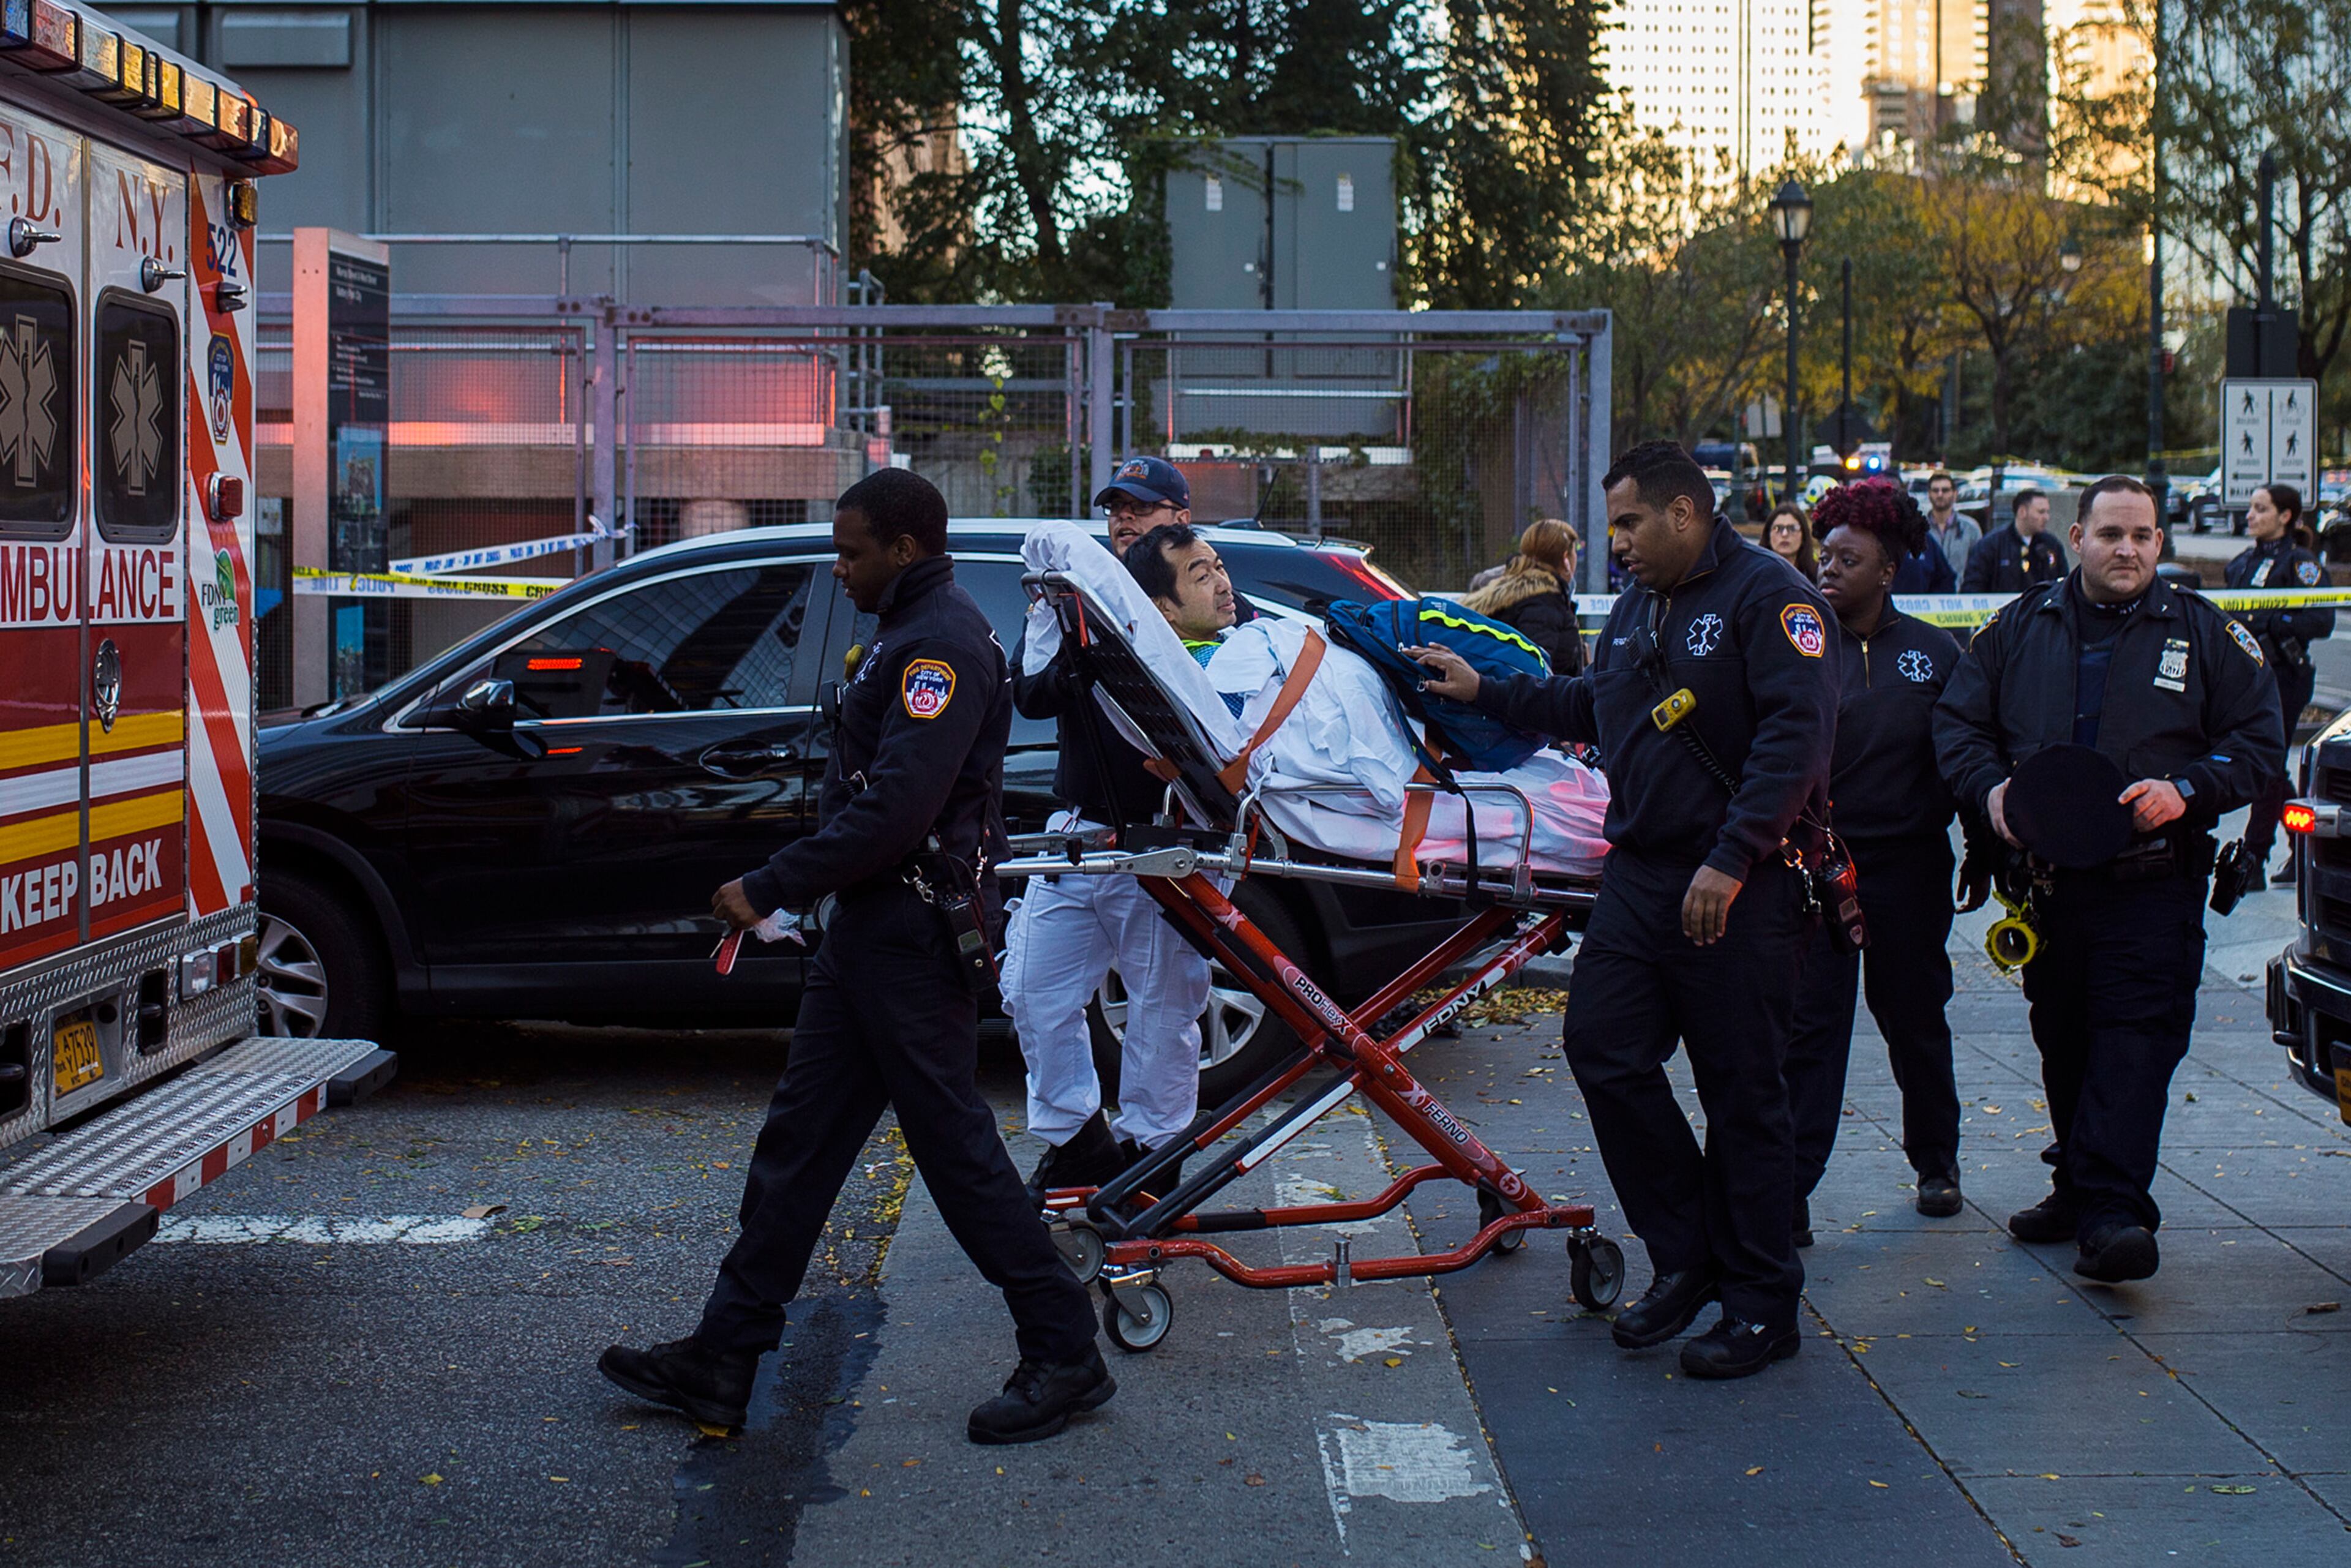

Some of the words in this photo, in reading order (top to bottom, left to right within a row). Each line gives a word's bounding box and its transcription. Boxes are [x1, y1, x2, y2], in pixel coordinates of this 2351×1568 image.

[116, 168, 173, 263] N.Y.
[206, 222, 237, 277] 522
[201, 583, 227, 606] FDNY
[214, 606, 239, 631] green
[1, 860, 79, 935] KEEP
[89, 838, 162, 908] BACK
[1423, 980, 1482, 1035] FDNY
[1423, 1101, 1469, 1144] FERNO
